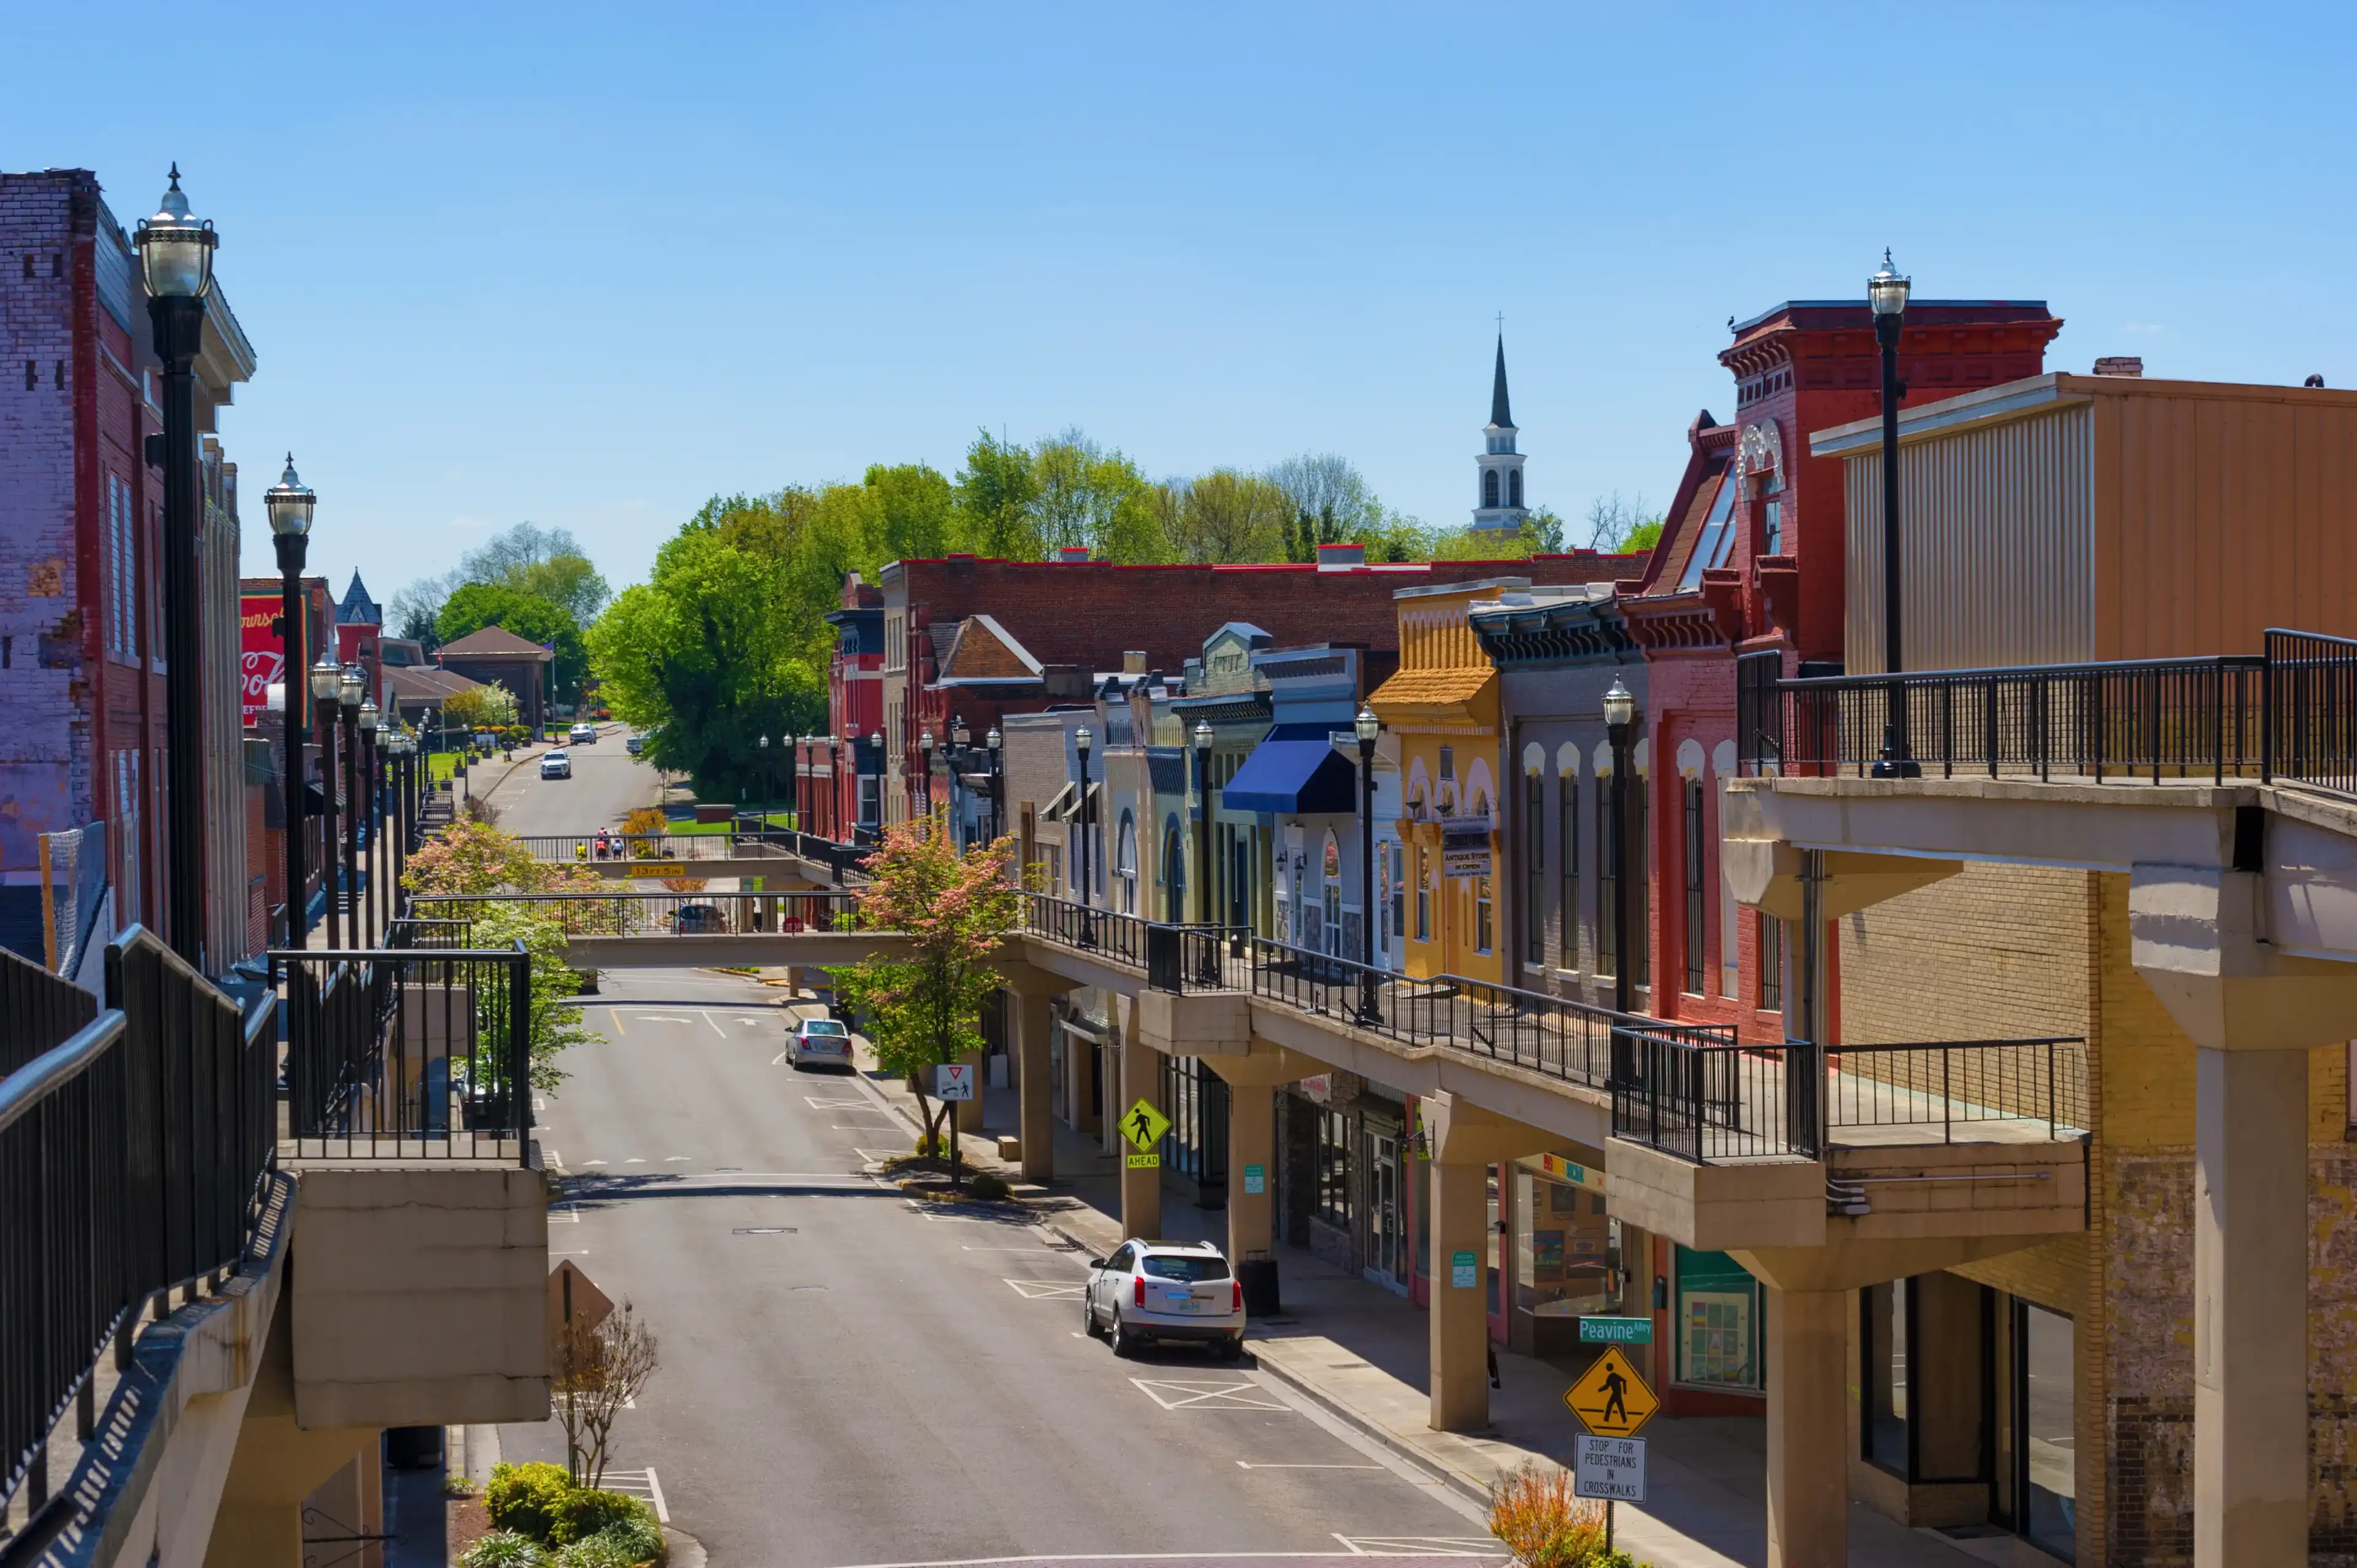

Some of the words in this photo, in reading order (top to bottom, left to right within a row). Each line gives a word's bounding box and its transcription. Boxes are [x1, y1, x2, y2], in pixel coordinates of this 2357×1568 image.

[1129, 1156, 1158, 1166] AHEAD
[1579, 1321, 1633, 1339] Peavine
[1634, 1322, 1651, 1334] Alley
[1590, 1440, 1609, 1451] STOP
[1619, 1442, 1633, 1454] FOR
[1585, 1453, 1636, 1469] PEDESTRIANS
[1607, 1469, 1614, 1481] IN
[1584, 1481, 1636, 1497] CROSSWALKS
